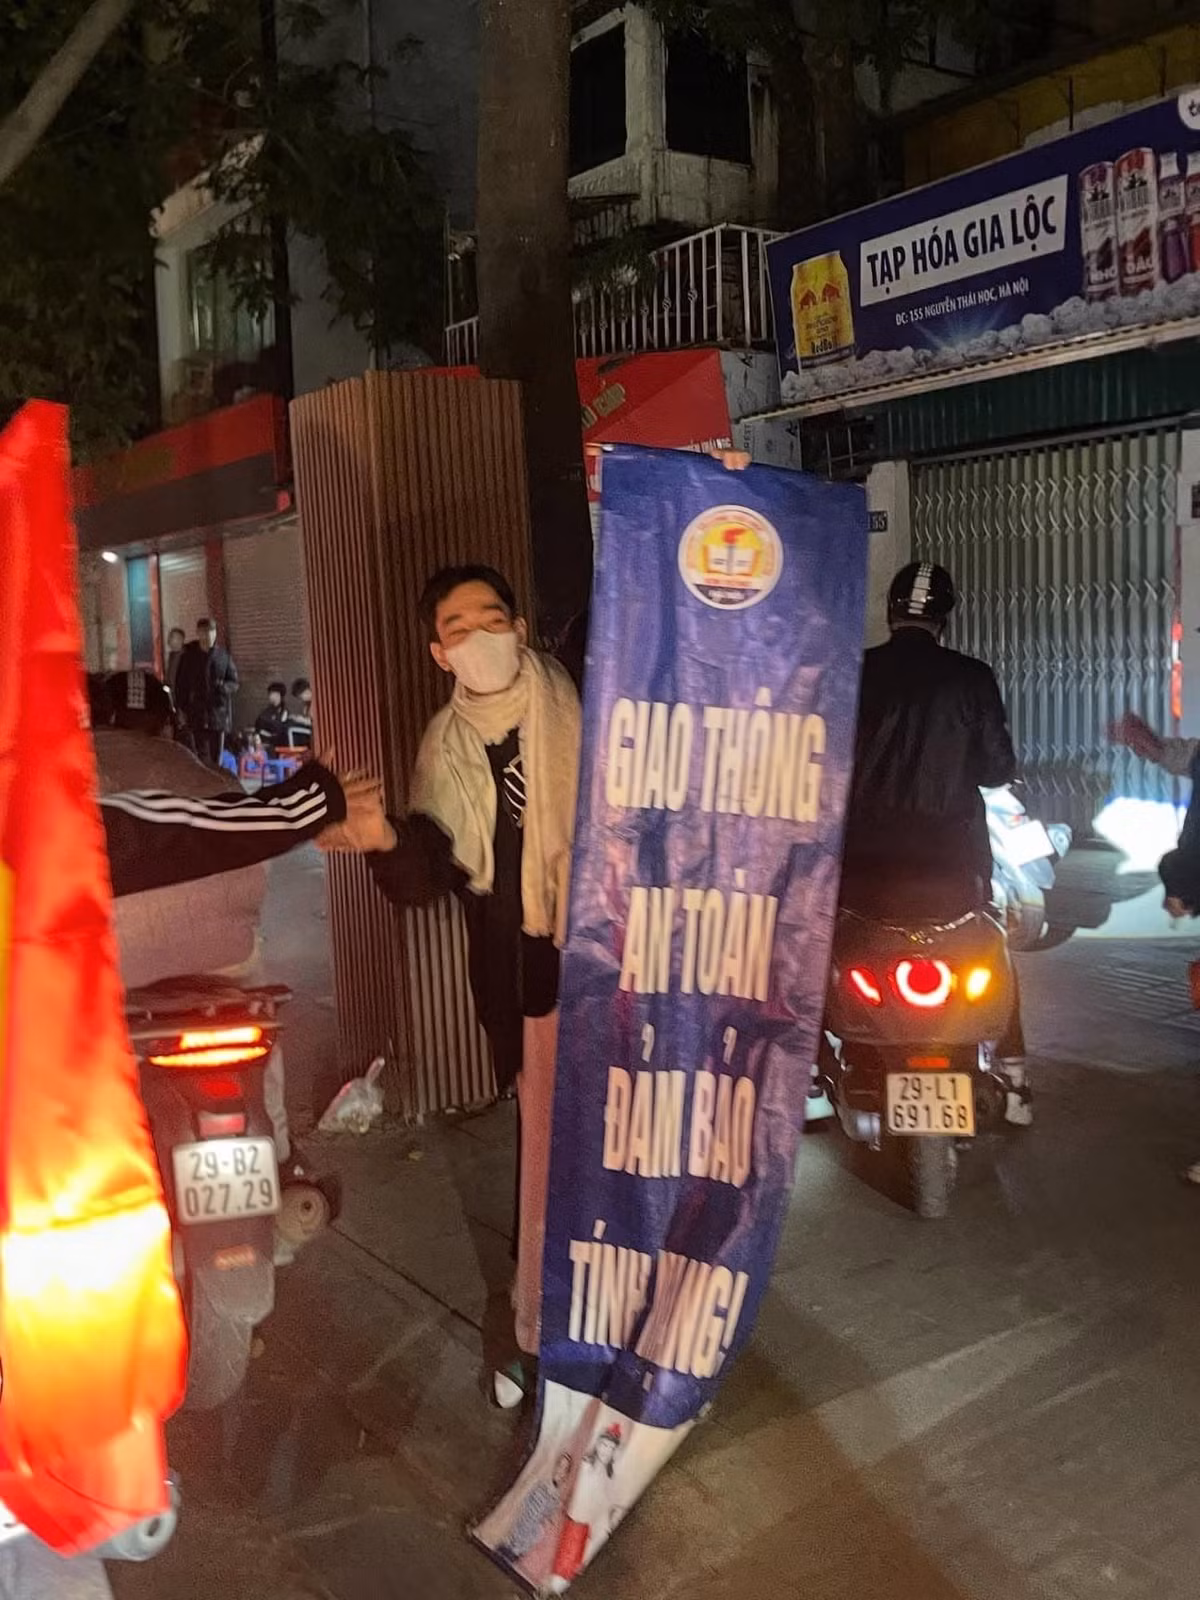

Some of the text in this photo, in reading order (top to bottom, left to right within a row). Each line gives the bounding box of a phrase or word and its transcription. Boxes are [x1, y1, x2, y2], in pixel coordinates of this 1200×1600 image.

[867, 246, 906, 294] TẠP
[912, 226, 959, 275] HÓA
[964, 214, 1004, 258] GIA
[1011, 195, 1056, 251] LỘC
[910, 307, 924, 322] 155
[606, 686, 827, 823] GIAO THÔNG
[619, 886, 675, 994] AN
[602, 1022, 756, 1189] ĐẢM BẢO
[899, 1077, 957, 1101] 29-L1
[893, 1104, 969, 1129] 691.68
[190, 1144, 262, 1181] 29-B2
[184, 1178, 273, 1217] 027.29
